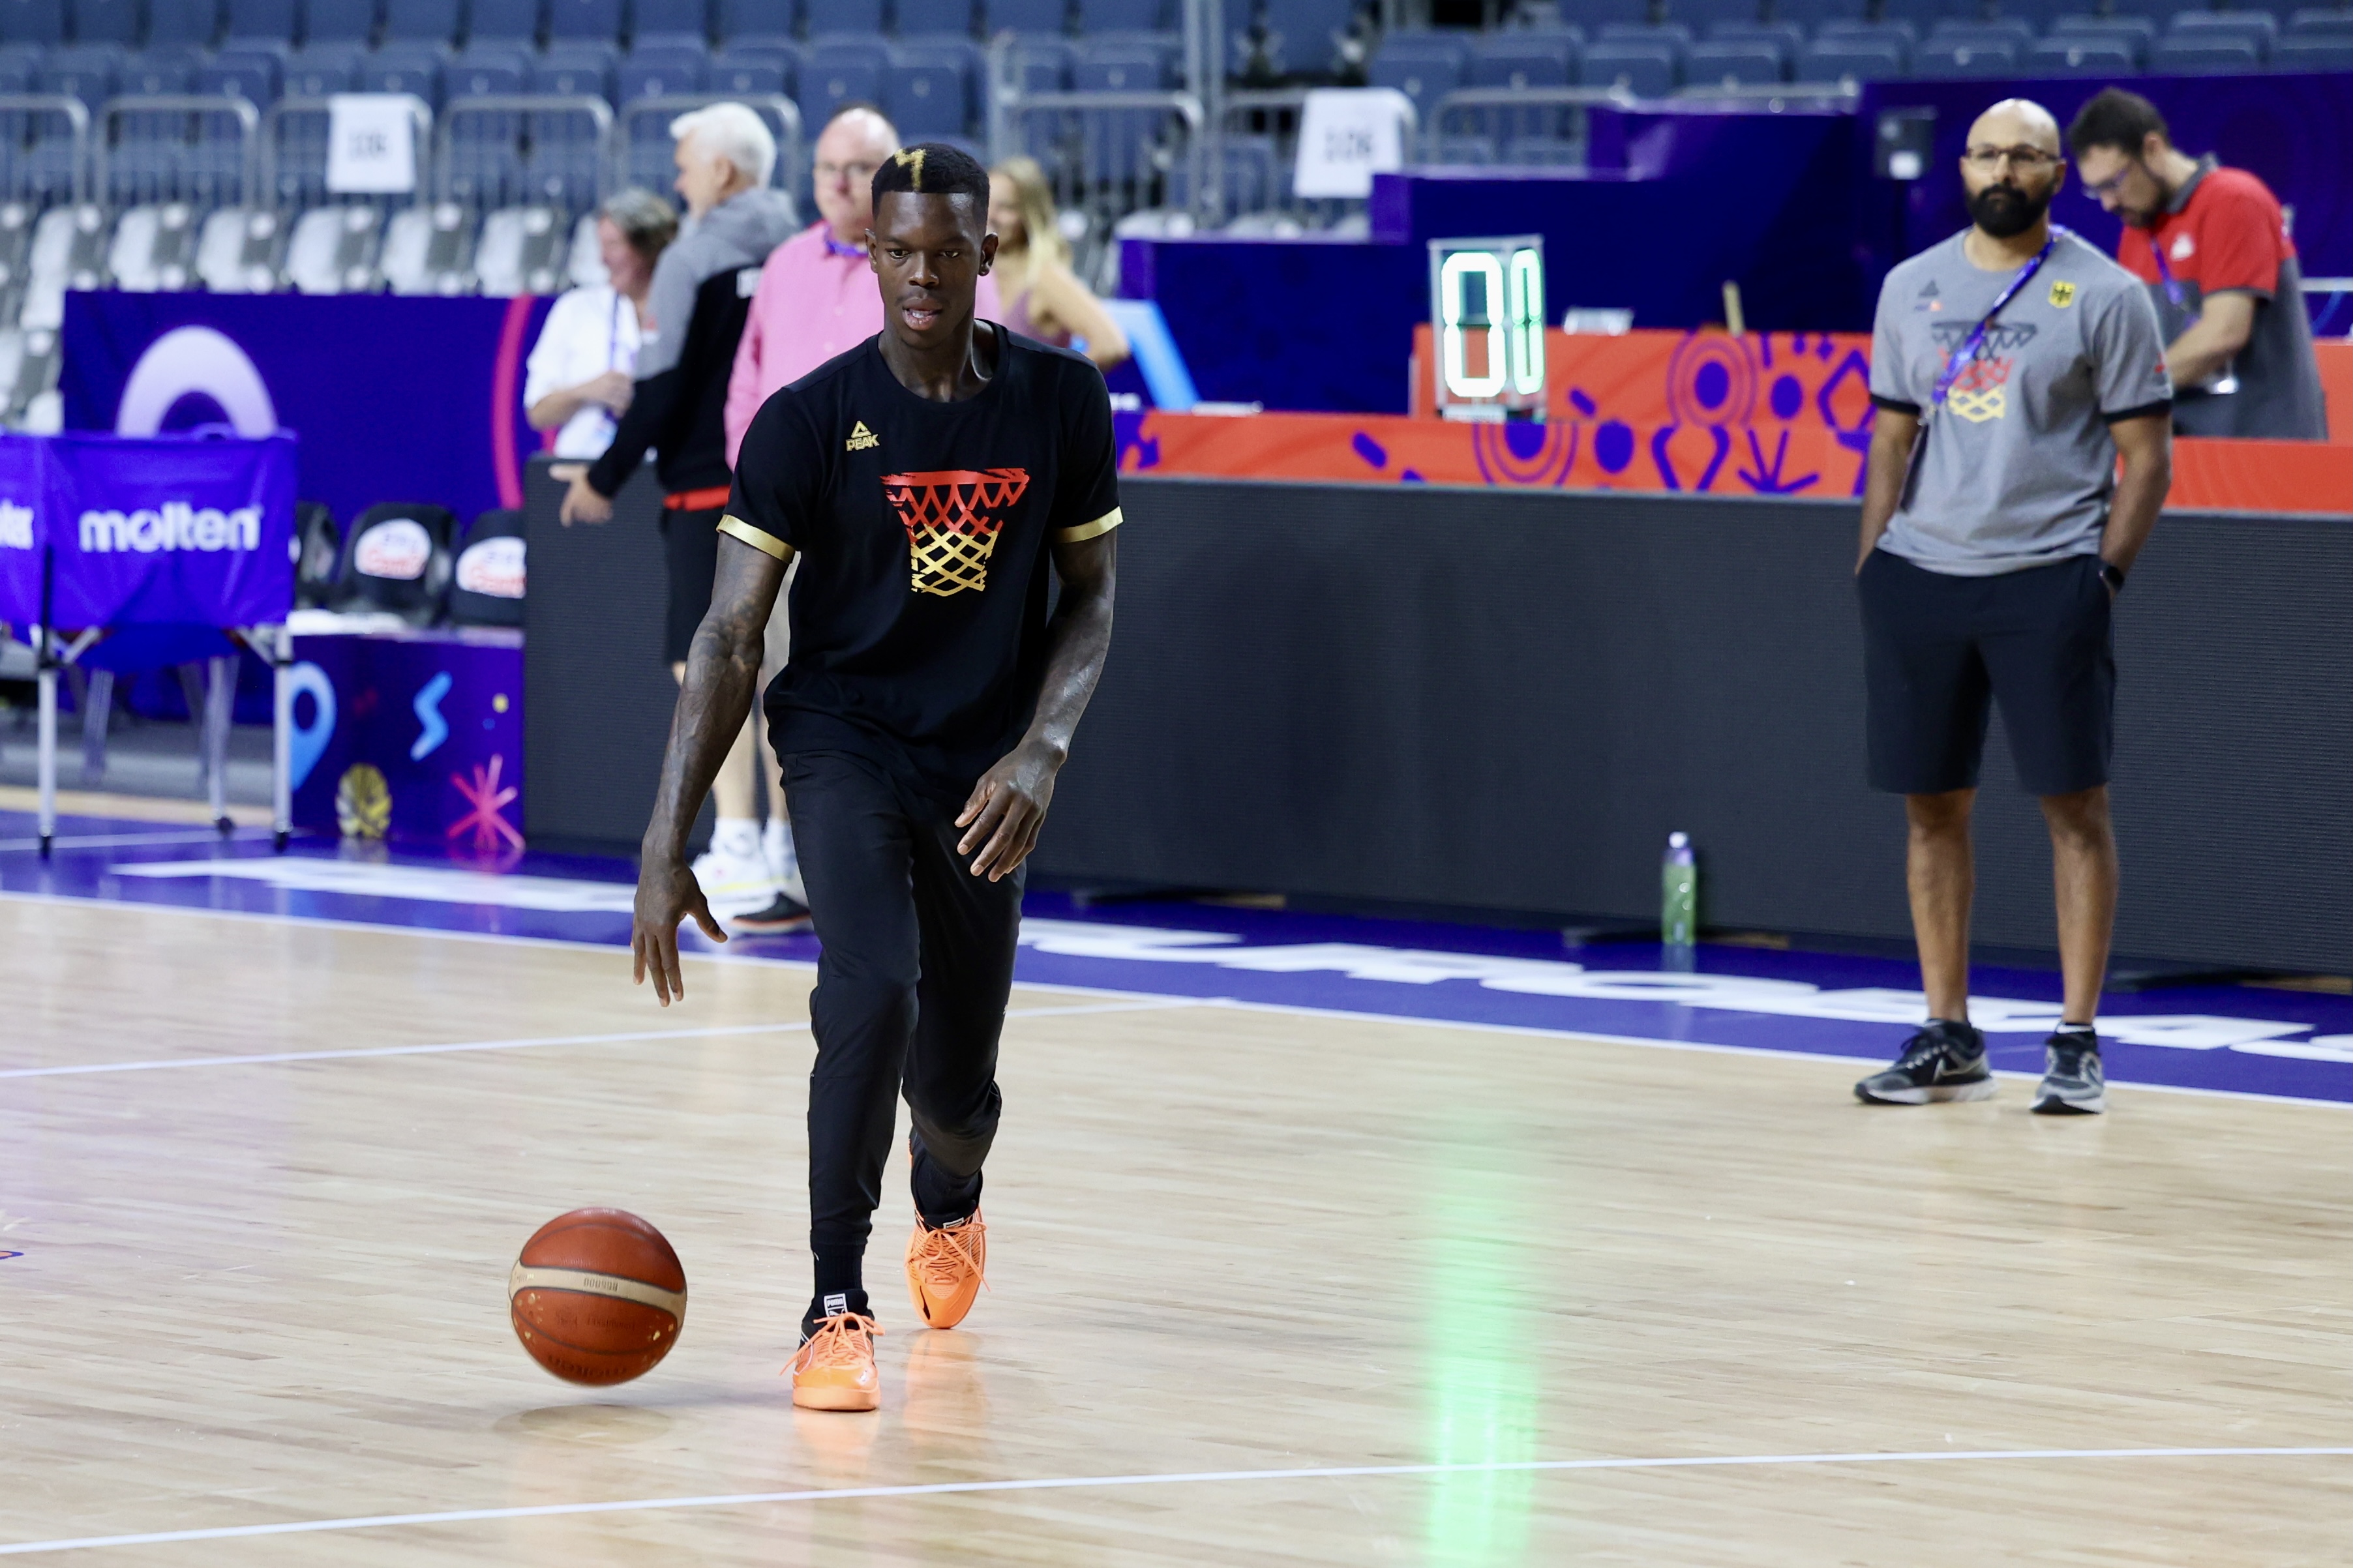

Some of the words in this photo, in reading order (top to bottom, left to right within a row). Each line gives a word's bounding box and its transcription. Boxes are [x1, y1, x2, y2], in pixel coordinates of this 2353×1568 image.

[845, 434, 880, 451] PEAK
[79, 501, 262, 553] molten
[827, 1297, 843, 1307] PUMA
